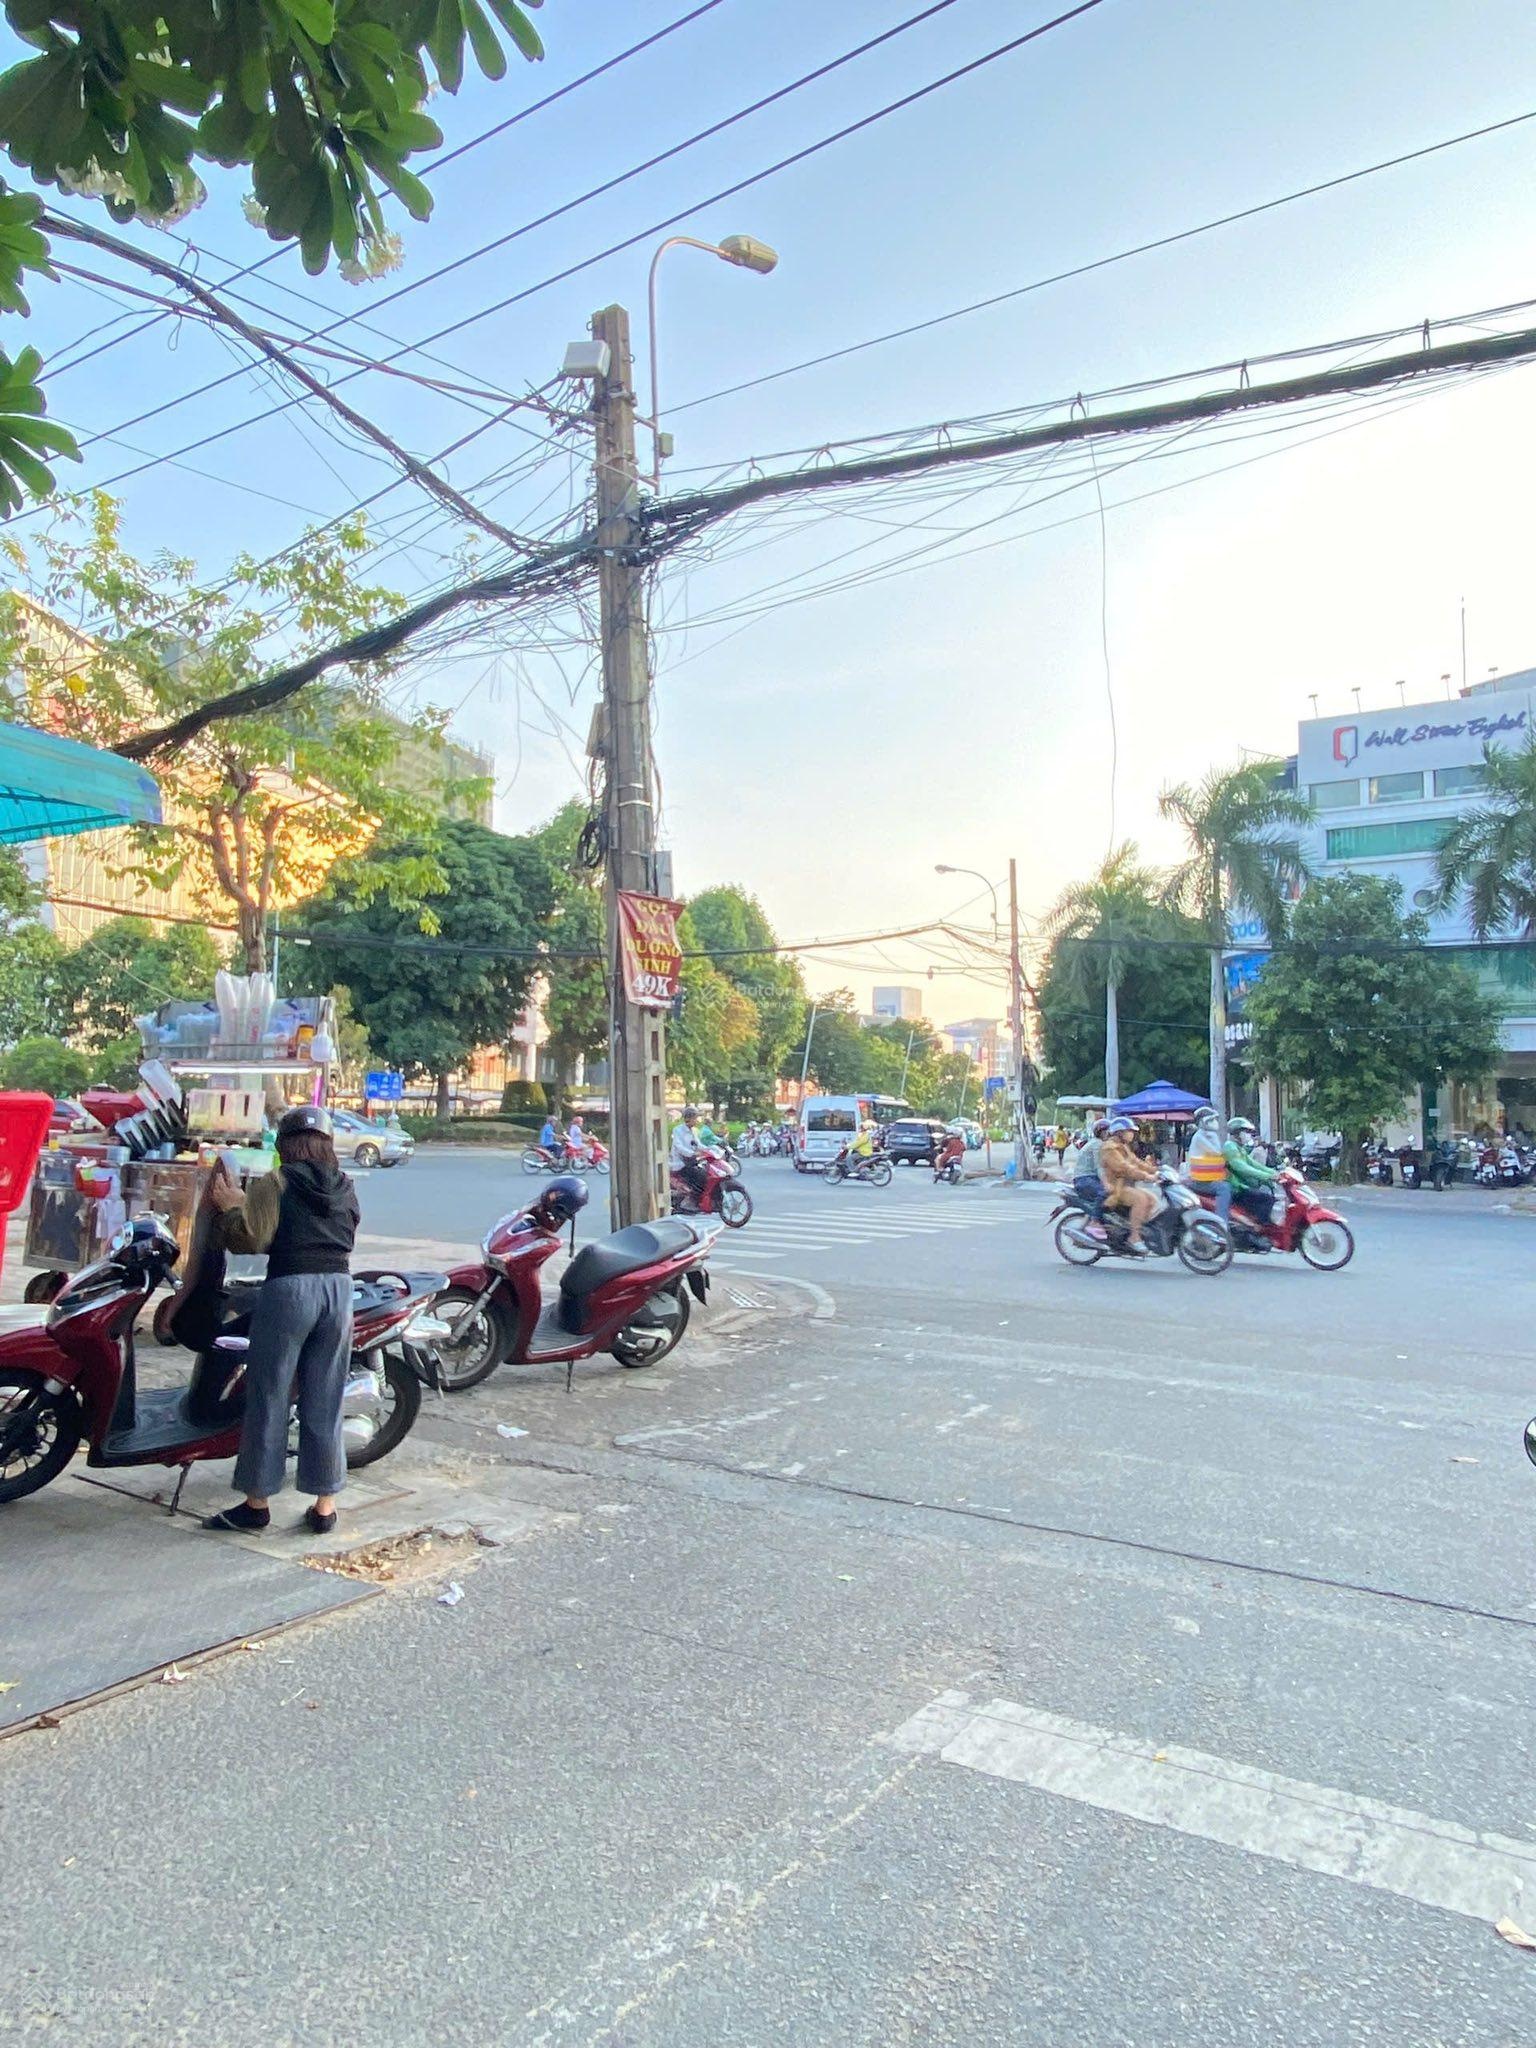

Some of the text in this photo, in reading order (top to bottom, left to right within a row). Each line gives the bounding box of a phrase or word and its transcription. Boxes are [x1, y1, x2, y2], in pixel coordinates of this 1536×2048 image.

[1364, 710, 1527, 748] Wall Street English
[632, 973, 673, 997] 49K
